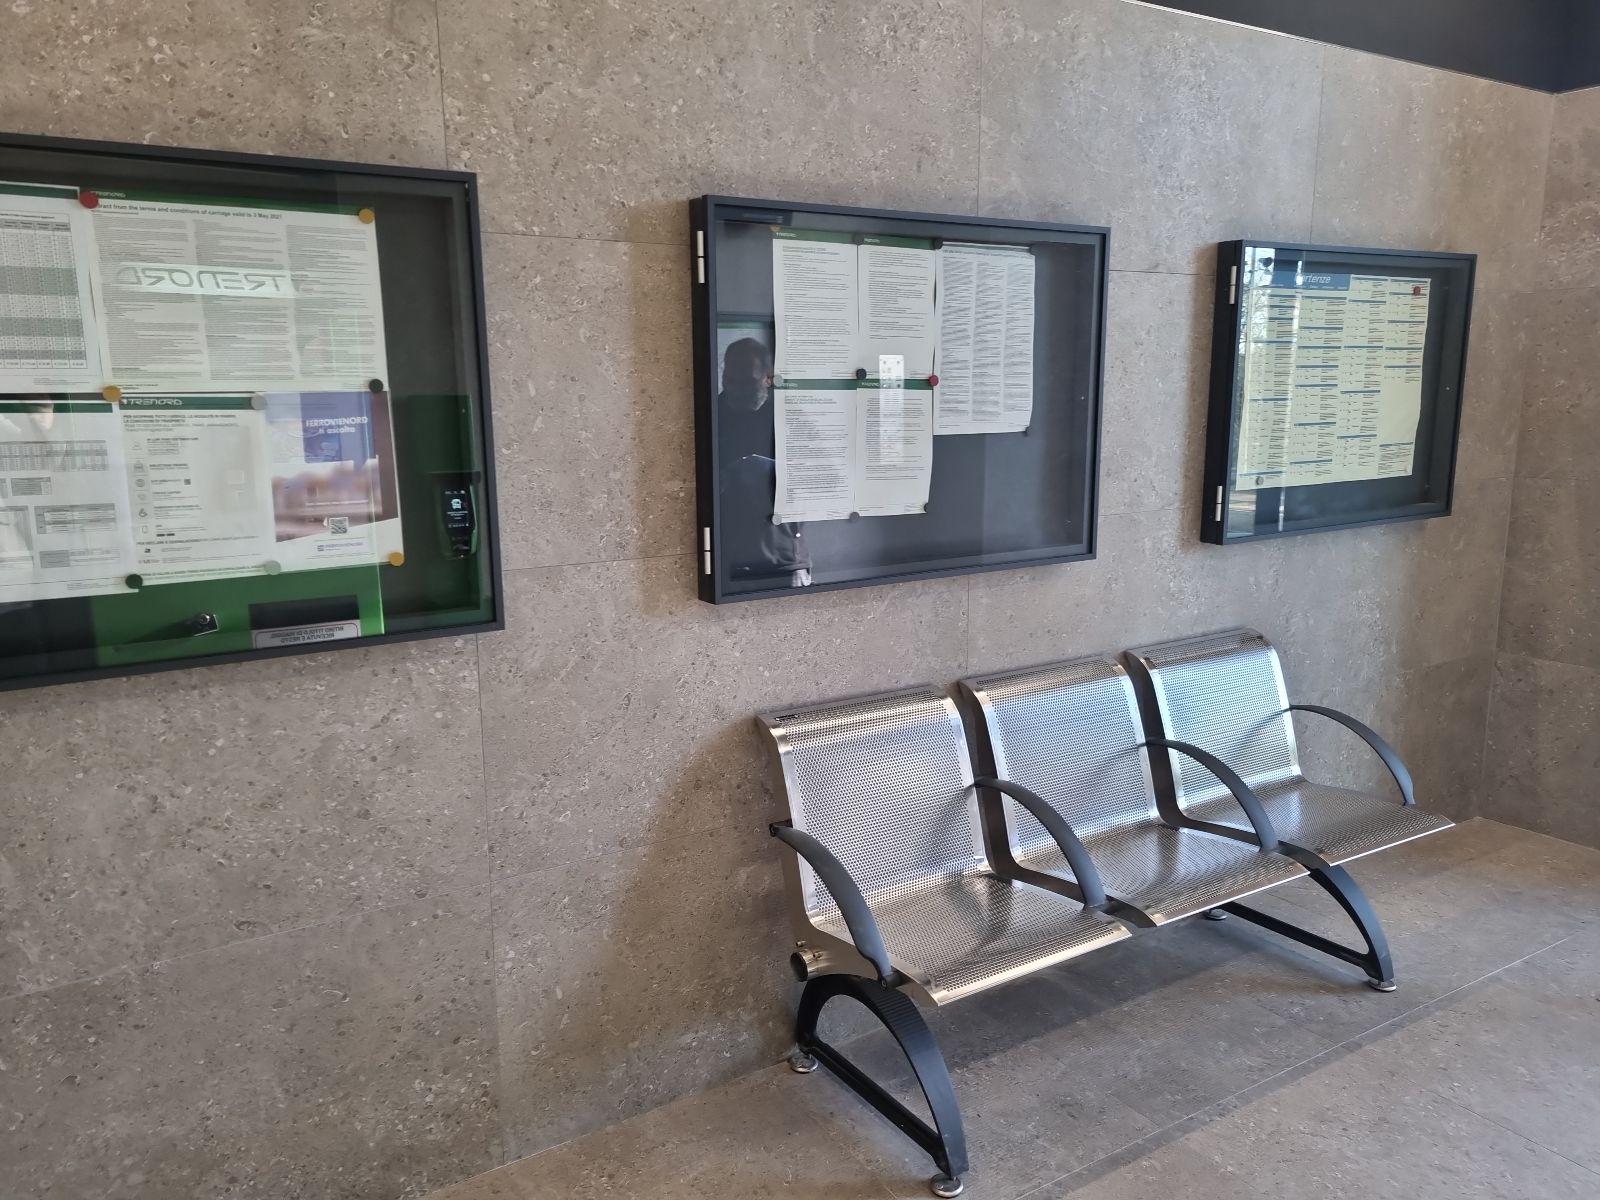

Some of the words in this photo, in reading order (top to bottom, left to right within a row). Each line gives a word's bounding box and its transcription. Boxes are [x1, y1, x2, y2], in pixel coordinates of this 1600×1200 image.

[127, 398, 183, 406] TRENORD
[305, 416, 368, 428] FERROVIENORD
[327, 425, 356, 434] ascolta
